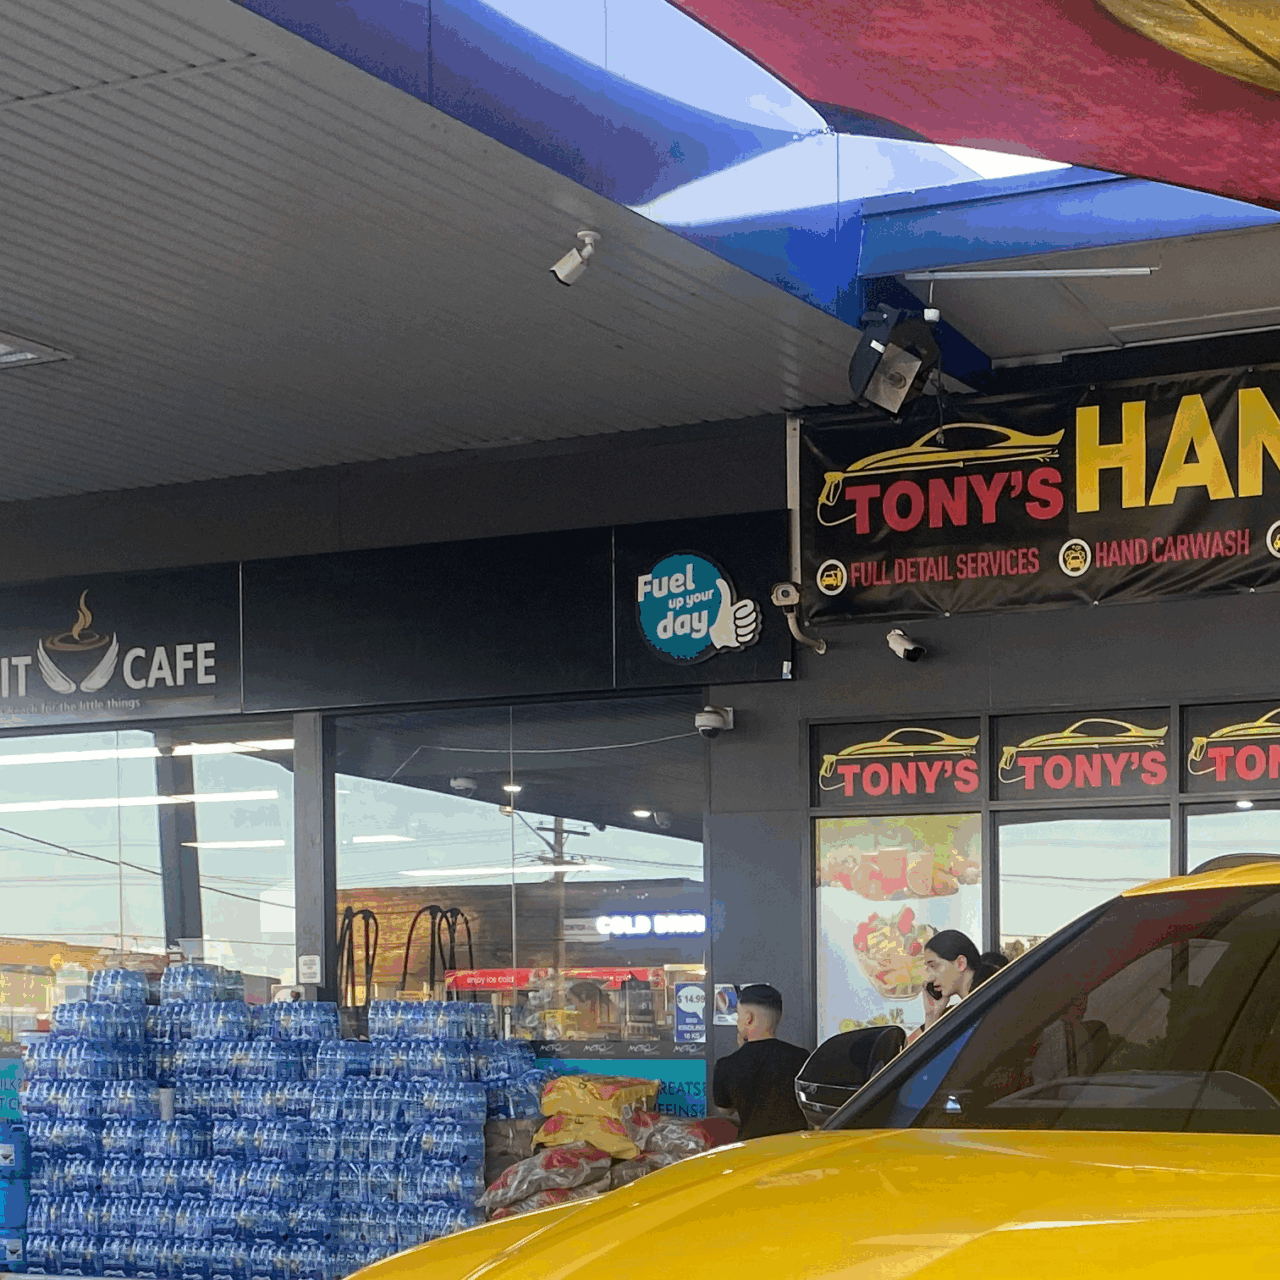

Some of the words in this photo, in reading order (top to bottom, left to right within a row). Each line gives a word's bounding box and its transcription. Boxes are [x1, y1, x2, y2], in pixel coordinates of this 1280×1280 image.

[845, 466, 1064, 534] TONY'S
[851, 560, 891, 587] FULL
[894, 556, 953, 584] DETAIL
[956, 547, 1040, 579] SERVICES
[1095, 540, 1149, 568] HAND
[1152, 528, 1250, 565] CARWASH
[638, 563, 695, 602] Fuel
[668, 597, 684, 610] up
[686, 589, 714, 608] your
[656, 610, 708, 639] day
[122, 642, 216, 690] CAFE
[79, 699, 104, 711] little
[107, 698, 141, 710] things
[837, 758, 979, 796] TONY'S
[1018, 750, 1167, 790] TONY'S
